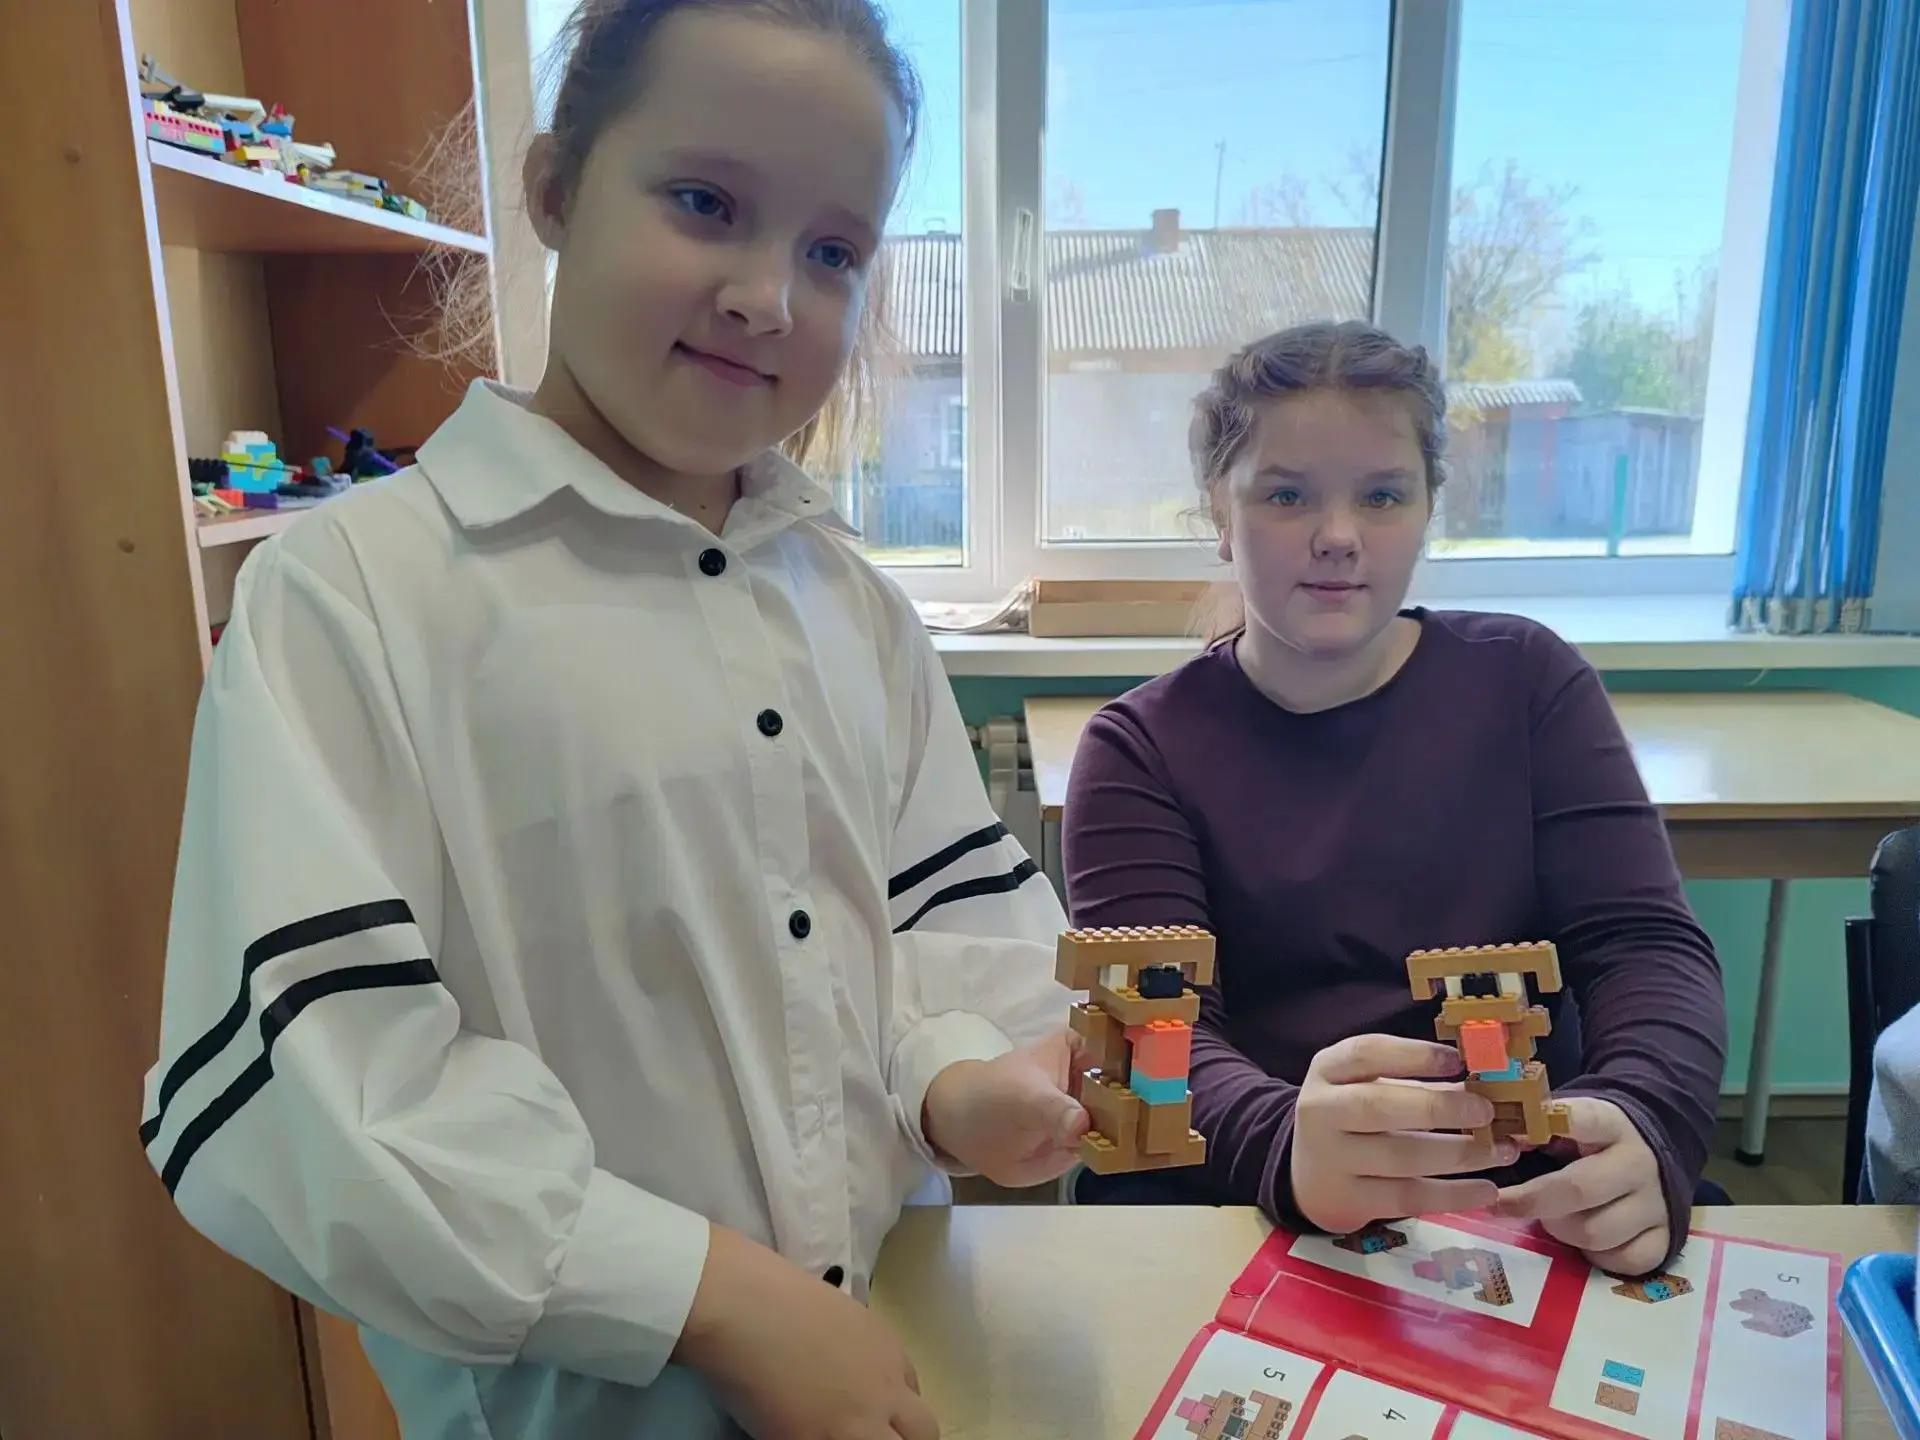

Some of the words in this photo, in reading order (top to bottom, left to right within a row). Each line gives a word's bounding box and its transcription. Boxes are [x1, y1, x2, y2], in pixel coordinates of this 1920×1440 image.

[1777, 1273, 1800, 1284] 5
[1263, 1366, 1286, 1382] 5
[1382, 1407, 1407, 1421] 4
